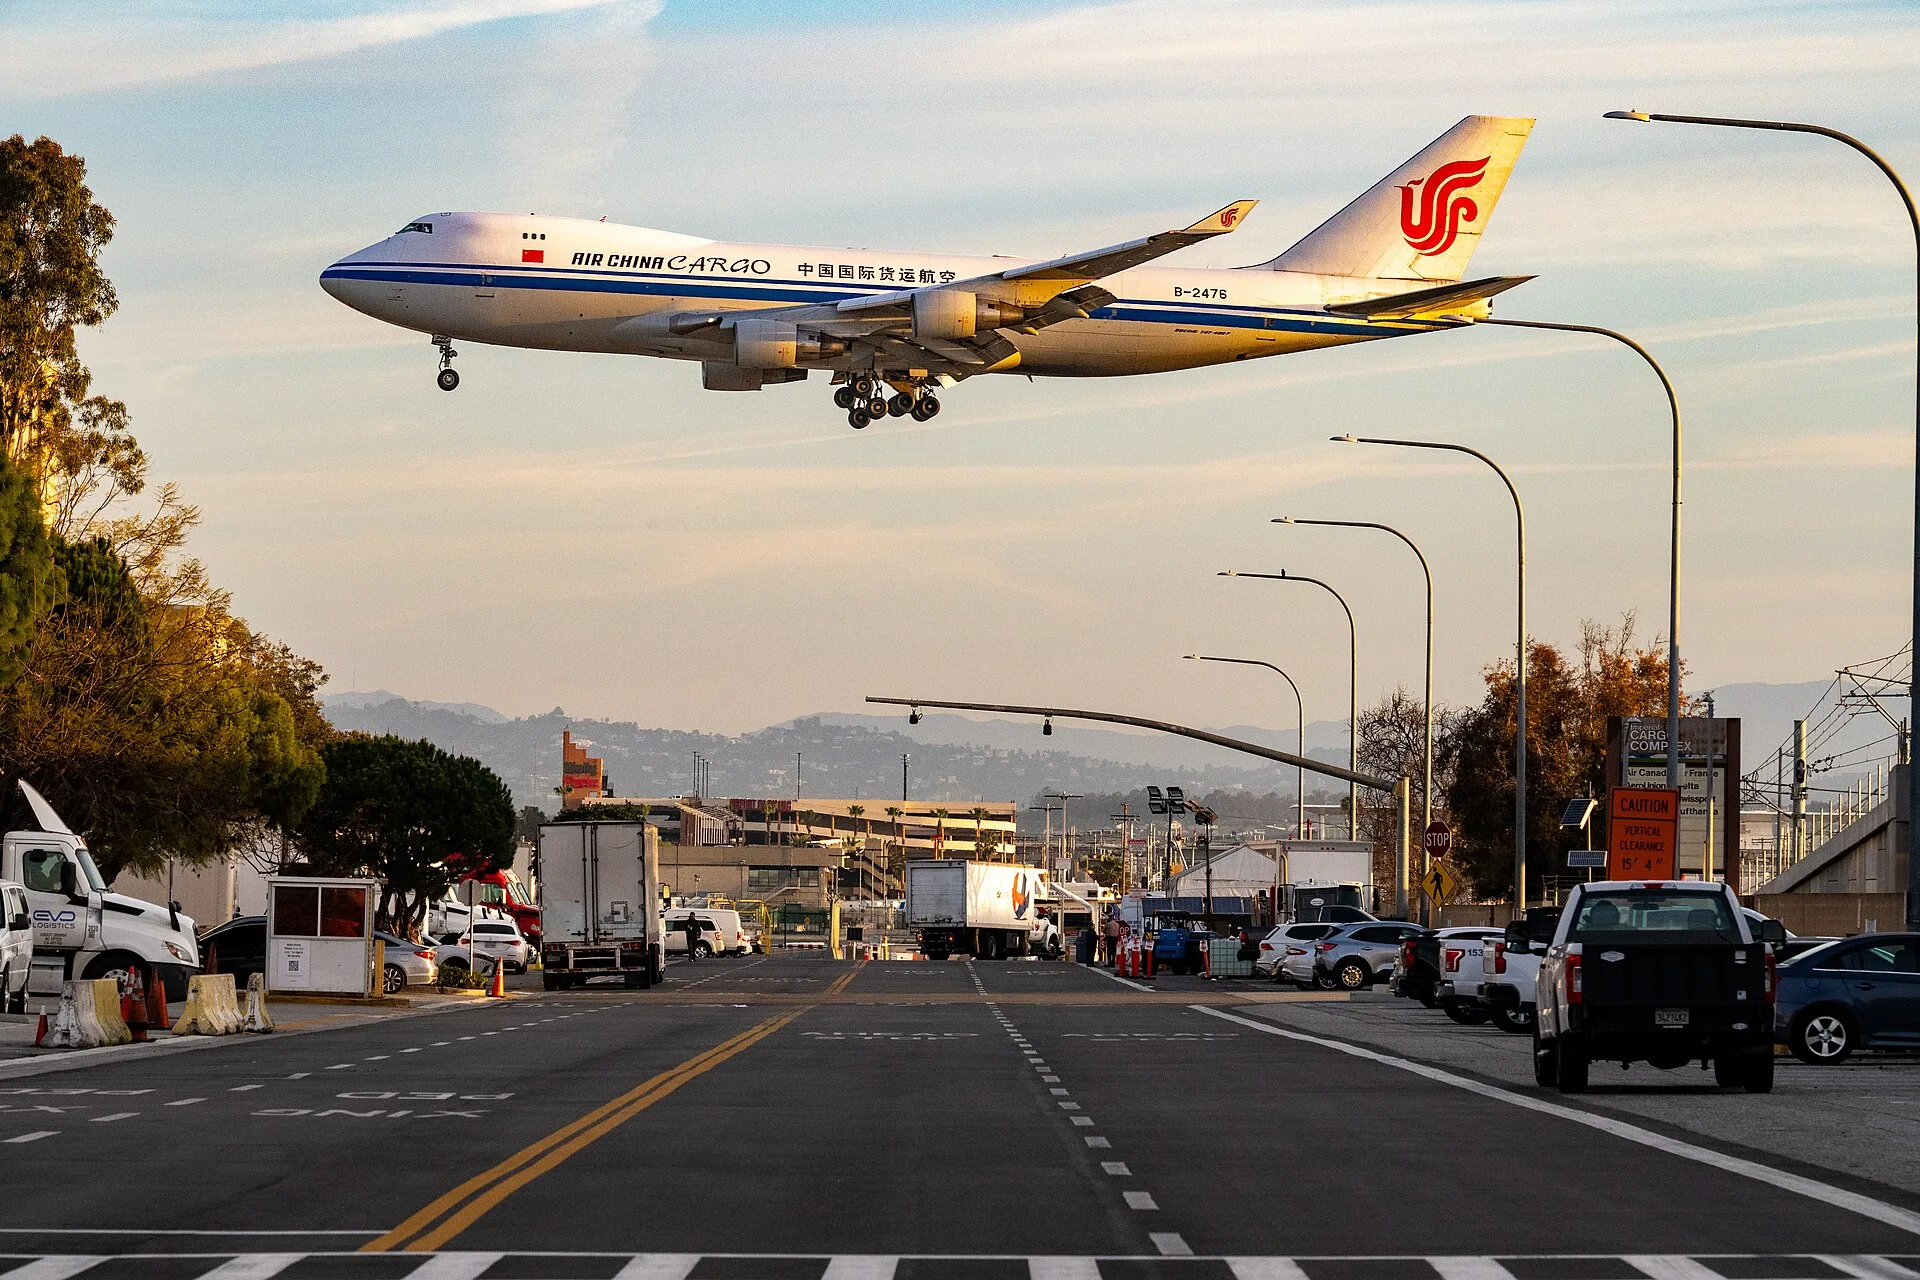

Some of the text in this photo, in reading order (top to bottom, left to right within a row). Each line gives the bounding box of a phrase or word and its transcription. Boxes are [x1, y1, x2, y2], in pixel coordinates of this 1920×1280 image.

[571, 252, 771, 275] AIR CHINA CARGO
[798, 262, 956, 284] 中国国际货运航空
[1174, 286, 1228, 300] B-2476
[1630, 723, 1660, 731] Imperial
[1630, 730, 1669, 740] CARG
[1630, 741, 1692, 751] COMPEX
[1639, 769, 1667, 777] Canad
[1689, 769, 1719, 777] Frane
[1680, 782, 1700, 790] elta
[1681, 795, 1716, 804] wisspot
[1620, 797, 1668, 813] CAUTION
[1681, 808, 1719, 816] ufthana
[1624, 825, 1662, 837] VERTICAL
[1426, 832, 1450, 847] STOP
[1619, 840, 1665, 852] CLEARANCE
[33, 910, 76, 922] EVO
[336, 1091, 516, 1100] PED
[250, 1109, 494, 1118] XING
